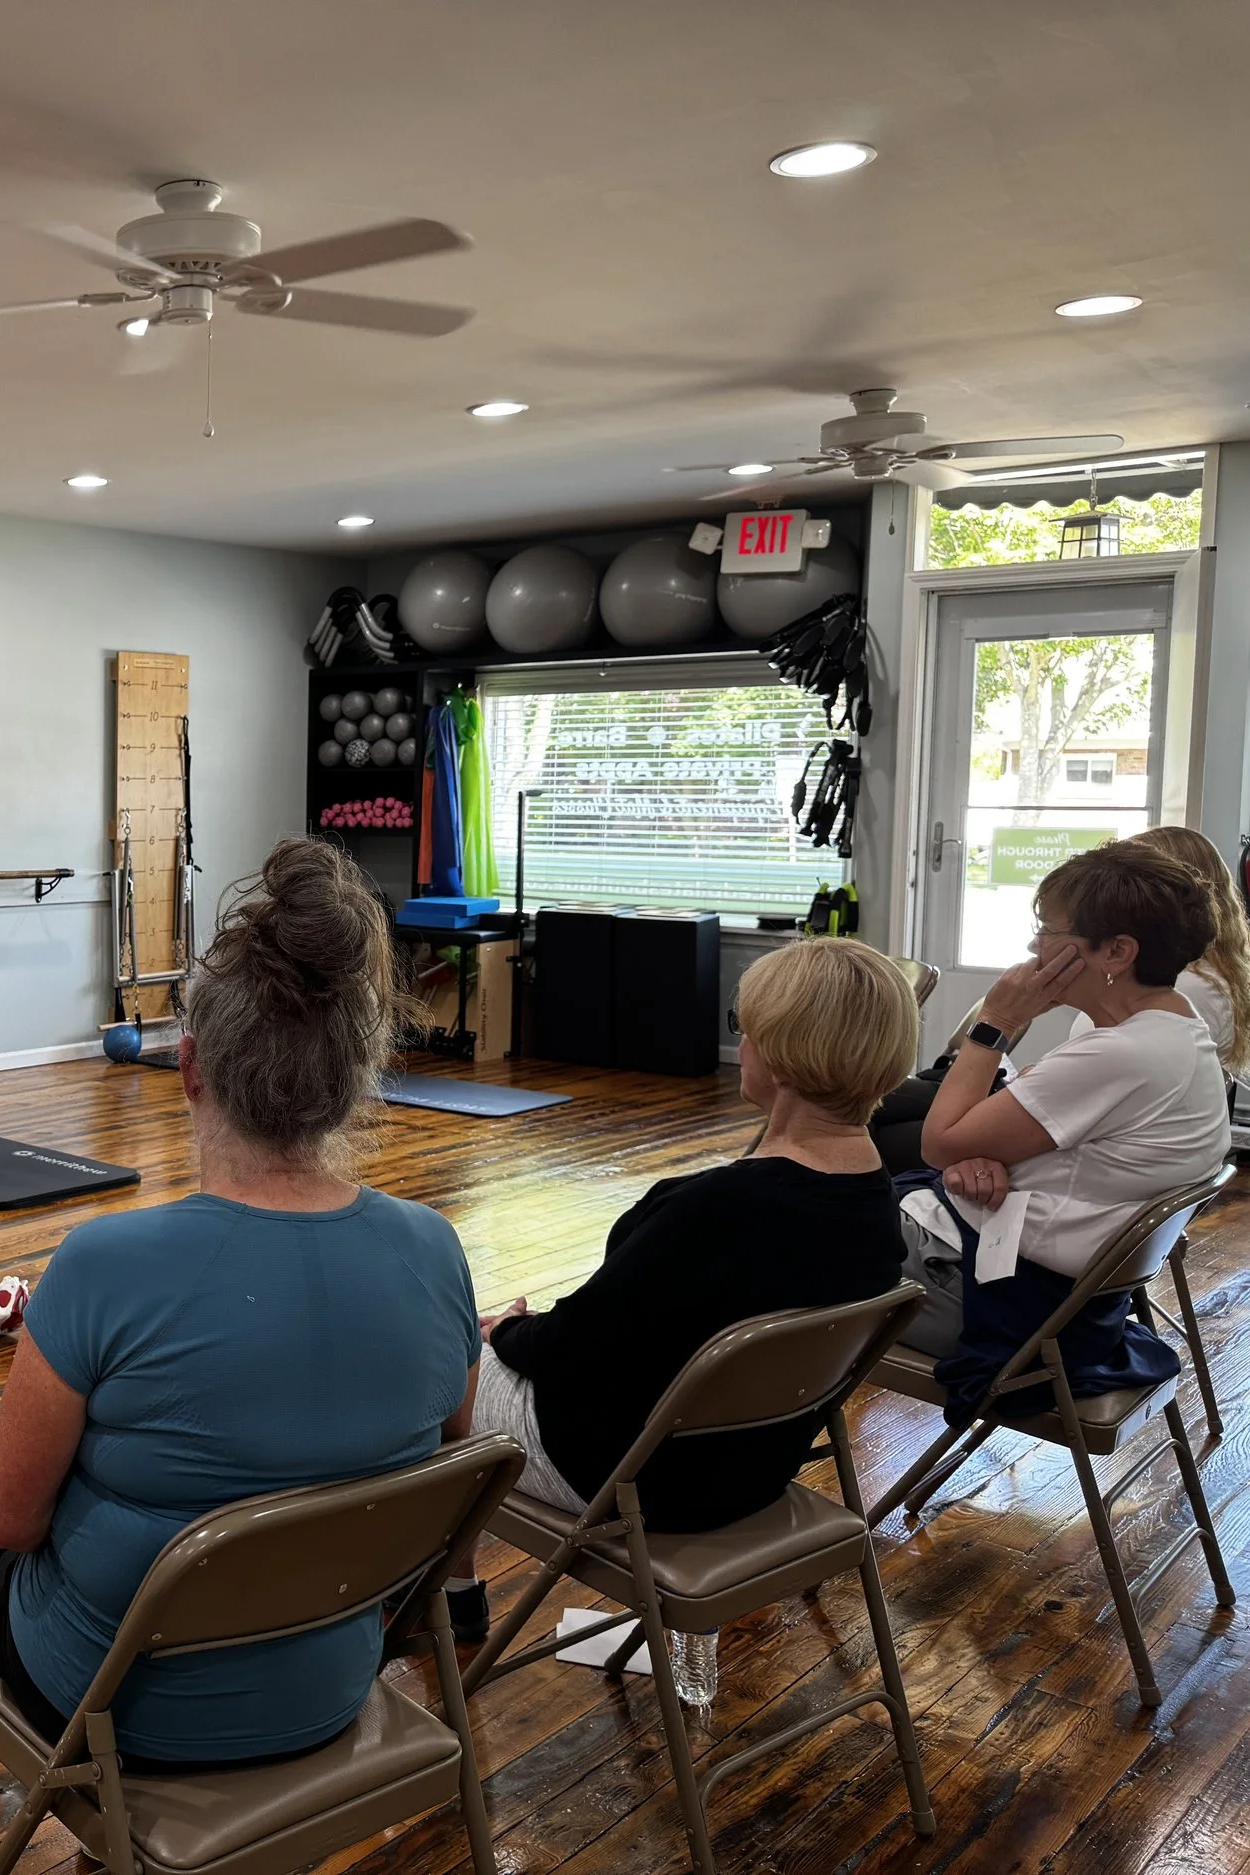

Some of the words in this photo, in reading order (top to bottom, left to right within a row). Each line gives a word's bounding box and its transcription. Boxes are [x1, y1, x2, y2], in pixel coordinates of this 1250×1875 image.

[738, 514, 794, 555] EXIT
[150, 680, 159, 691] 11
[149, 711, 160, 722] 10
[150, 742, 156, 753] 9
[150, 774, 156, 784] 8
[150, 805, 156, 815] 7
[149, 836, 155, 846] 6
[149, 866, 155, 876] 5
